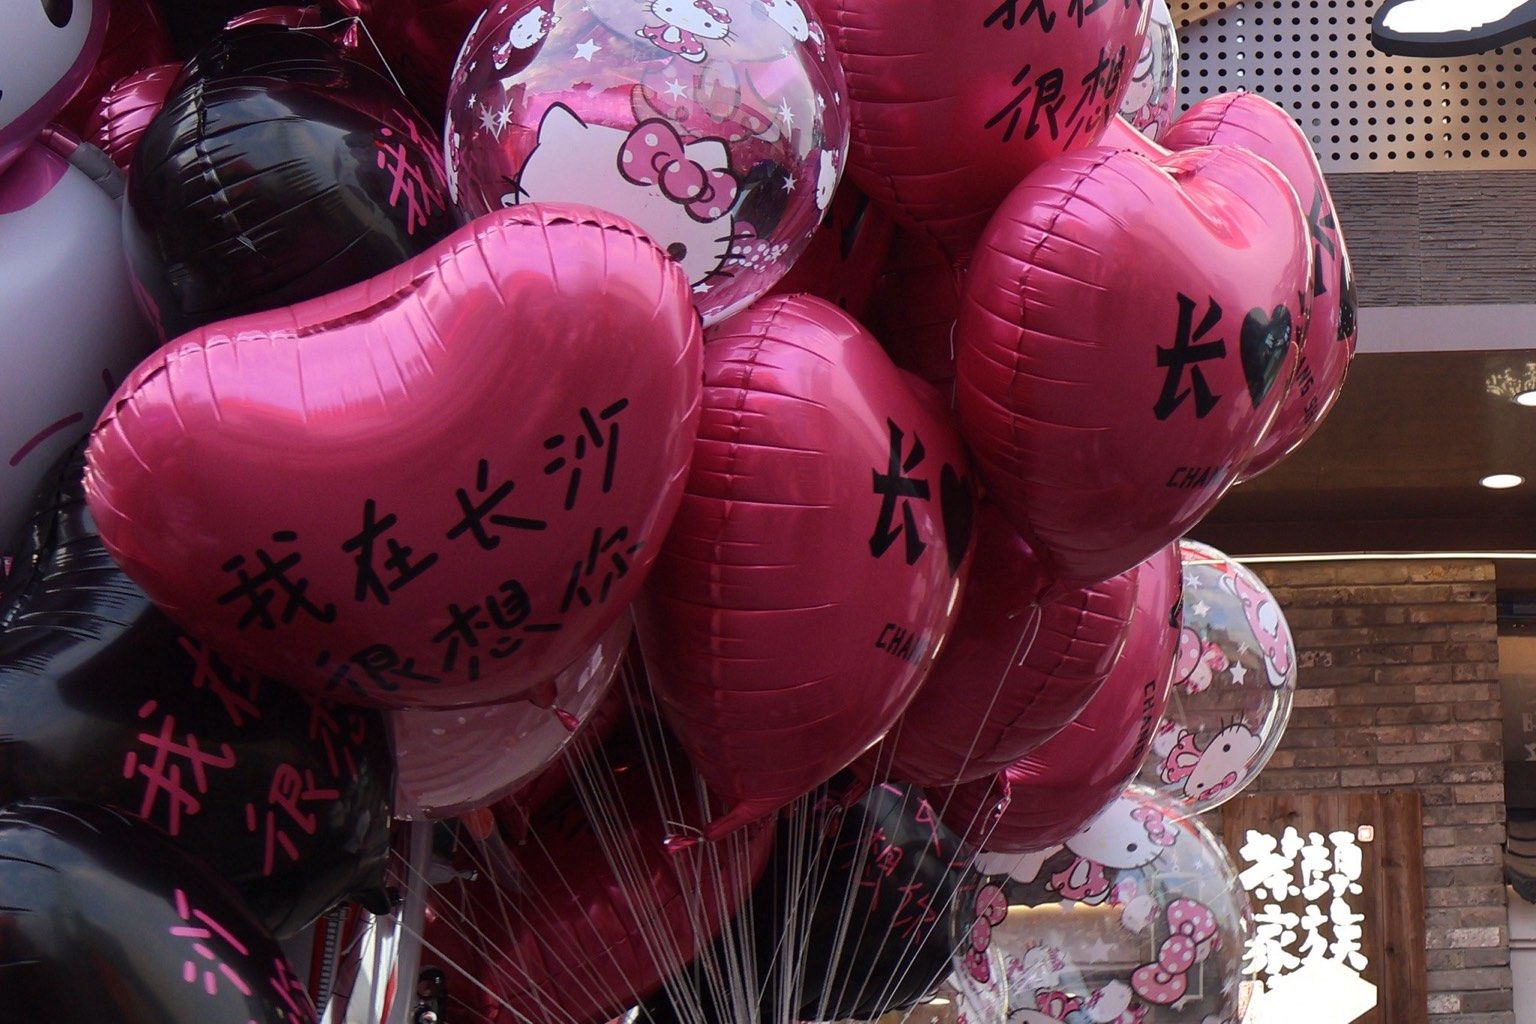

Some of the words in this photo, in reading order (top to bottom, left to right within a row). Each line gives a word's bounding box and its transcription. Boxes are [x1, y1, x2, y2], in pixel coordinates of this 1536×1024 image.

[217, 398, 629, 631] 我在长沙
[316, 526, 646, 693] 很想你
